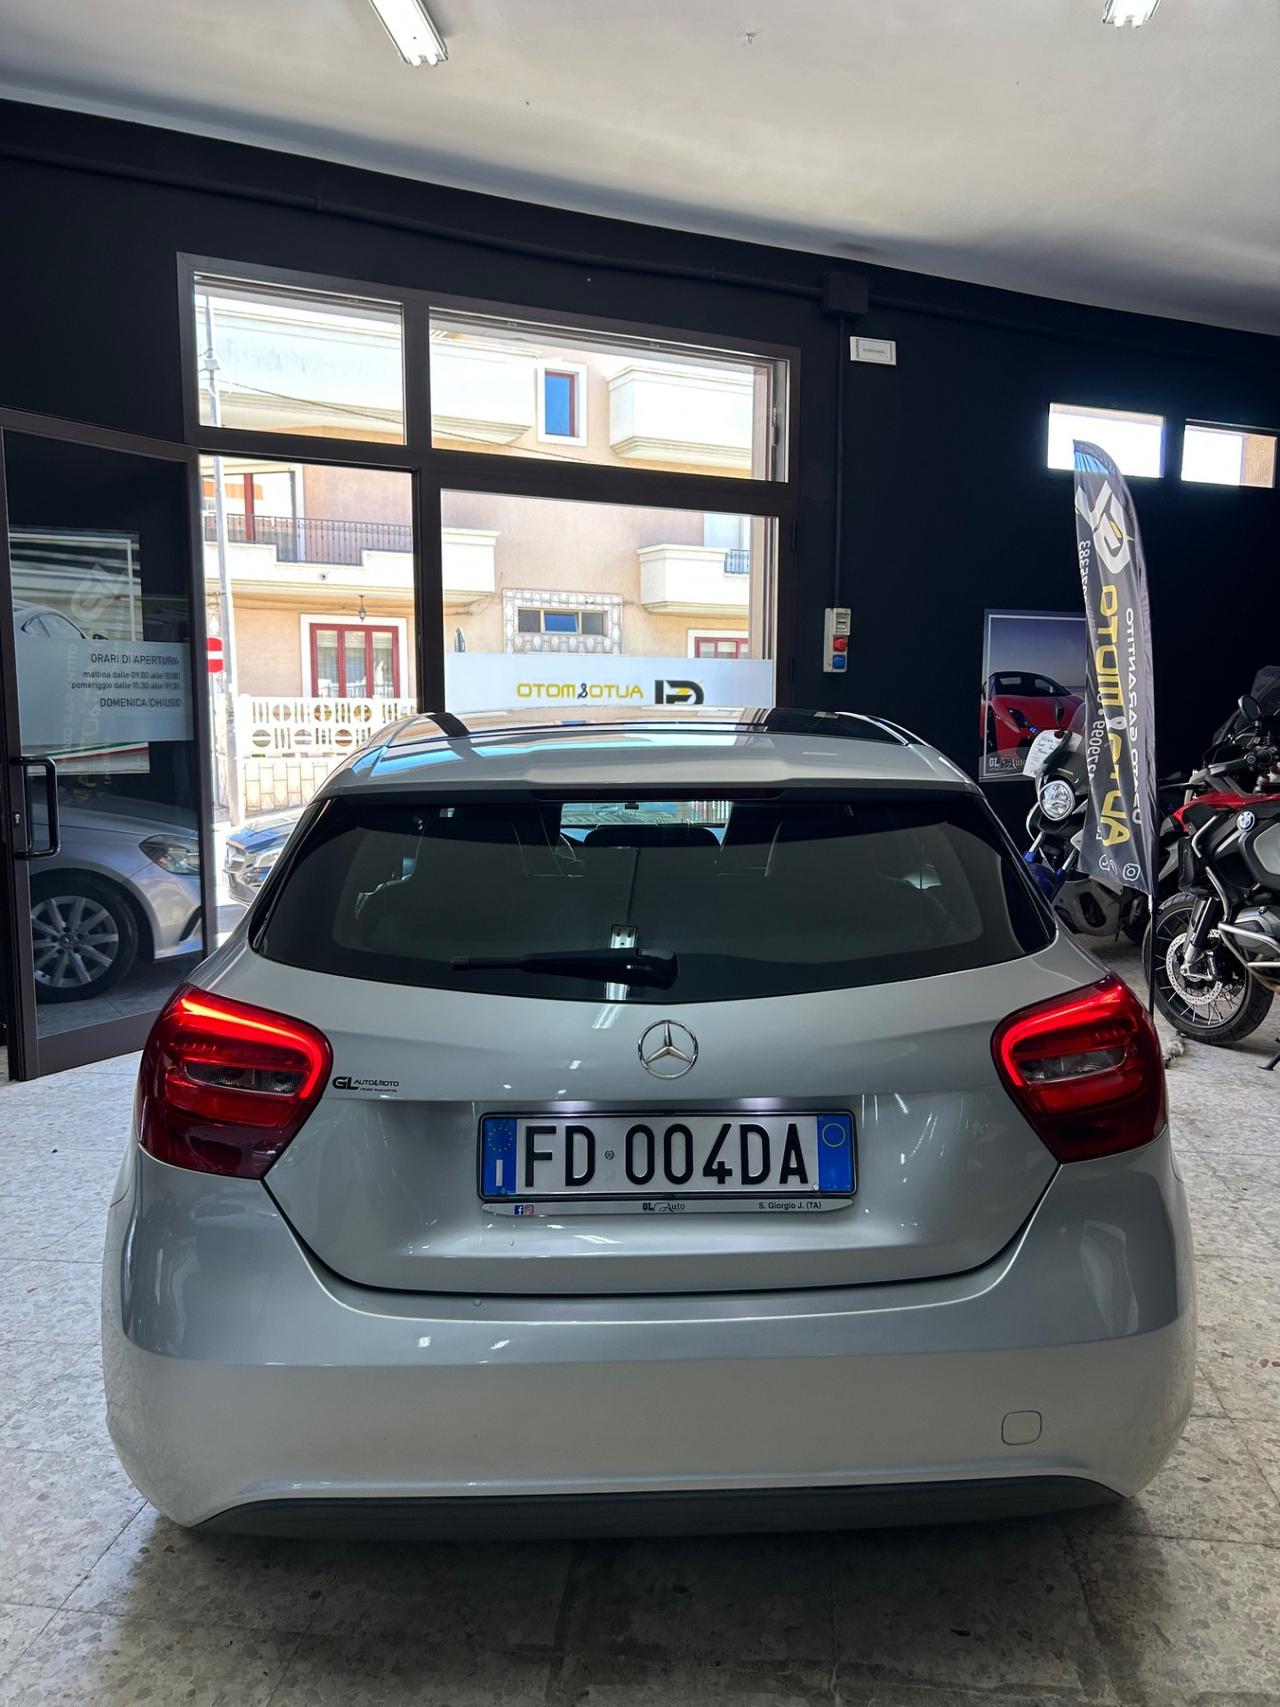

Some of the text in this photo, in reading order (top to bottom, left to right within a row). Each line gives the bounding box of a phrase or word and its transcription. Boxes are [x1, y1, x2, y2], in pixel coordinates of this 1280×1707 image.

[91, 653, 180, 665] ORARI DI APERTURA
[83, 671, 111, 679] mattina
[113, 671, 129, 679] dalle
[72, 682, 112, 690] pomeriggio
[114, 682, 130, 690] dalle
[100, 698, 181, 708] DOMENICA CHIUSO
[332, 1077, 359, 1090] GL
[525, 1125, 596, 1187] FD
[625, 1123, 809, 1185] 004DA
[642, 1202, 653, 1211] GL
[768, 1202, 796, 1210] Giorgio
[807, 1202, 822, 1210] (TA)
